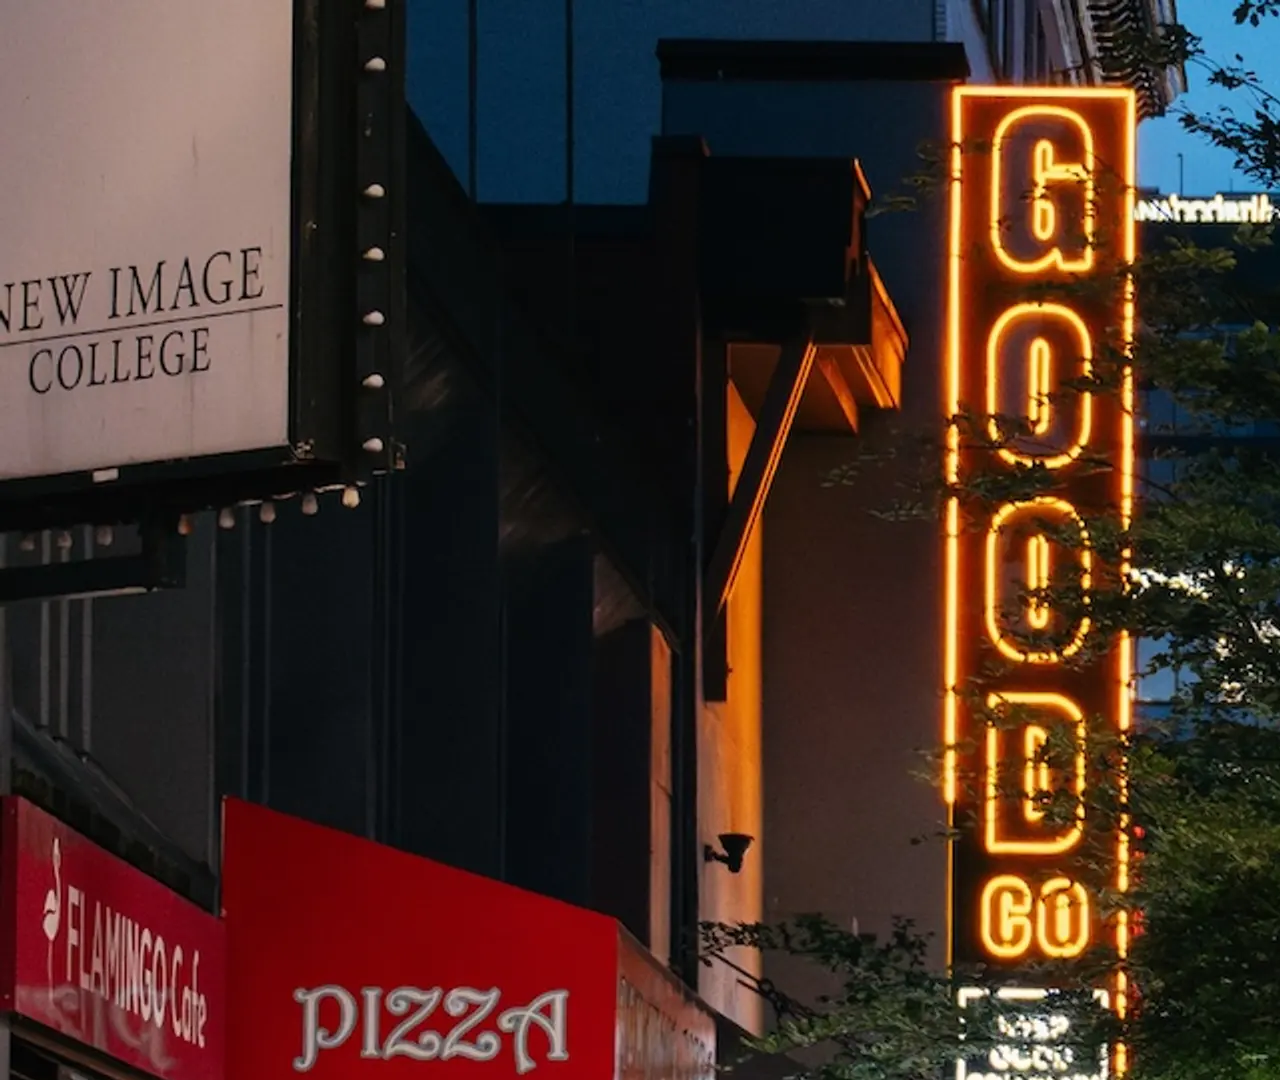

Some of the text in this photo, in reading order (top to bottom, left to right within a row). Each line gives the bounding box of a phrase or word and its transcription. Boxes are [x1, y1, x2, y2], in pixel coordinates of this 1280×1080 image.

[0, 247, 264, 333] NEW IMAGE
[29, 328, 213, 394] COLLEGE
[985, 106, 1093, 855] GOOD
[981, 875, 1090, 958] CO
[67, 884, 167, 1029] FLAMINGO
[172, 944, 207, 1048] Cafe
[292, 984, 570, 1075] PIZZA
